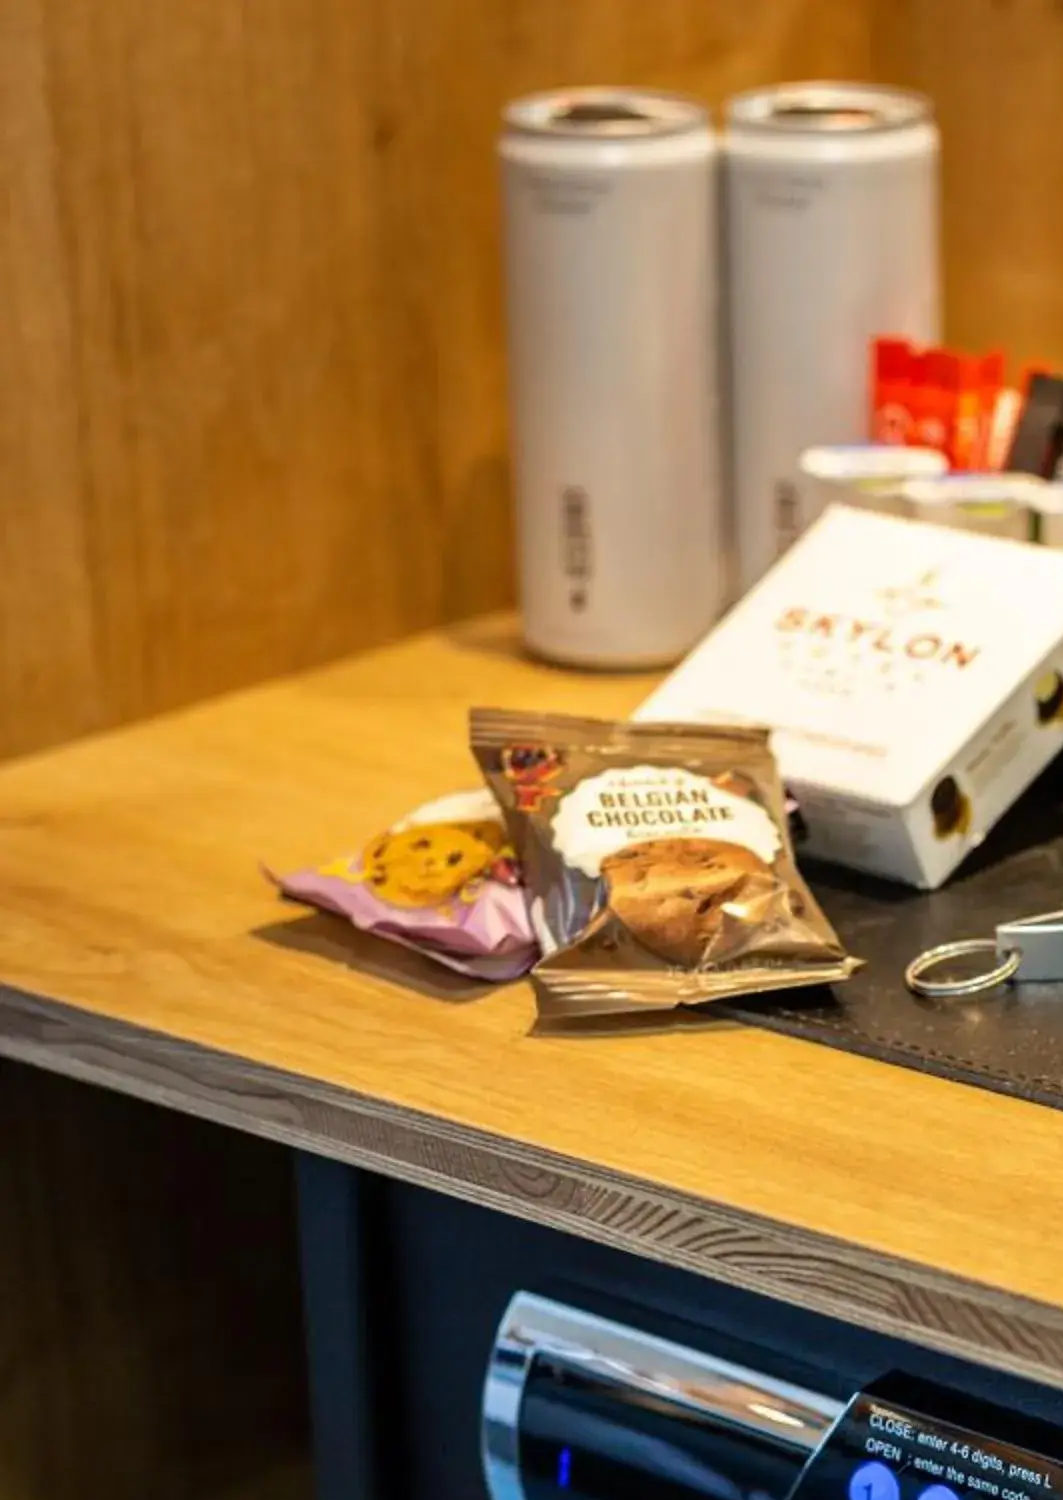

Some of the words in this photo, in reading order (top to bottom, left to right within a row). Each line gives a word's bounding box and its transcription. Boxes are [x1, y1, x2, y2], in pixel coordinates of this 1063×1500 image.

[775, 606, 981, 670] SKYLON
[586, 806, 735, 827] CHOCOLATE
[599, 789, 709, 807] BELGIAN
[869, 1413, 915, 1440] CLOSE:
[917, 1432, 948, 1451] enter
[950, 1442, 969, 1459] 4-6
[971, 1450, 1005, 1476] digits,
[1008, 1464, 1046, 1483] press
[1044, 1474, 1053, 1489] L
[913, 1456, 945, 1476] enter
[946, 1466, 966, 1484] the
[967, 1474, 999, 1496] same
